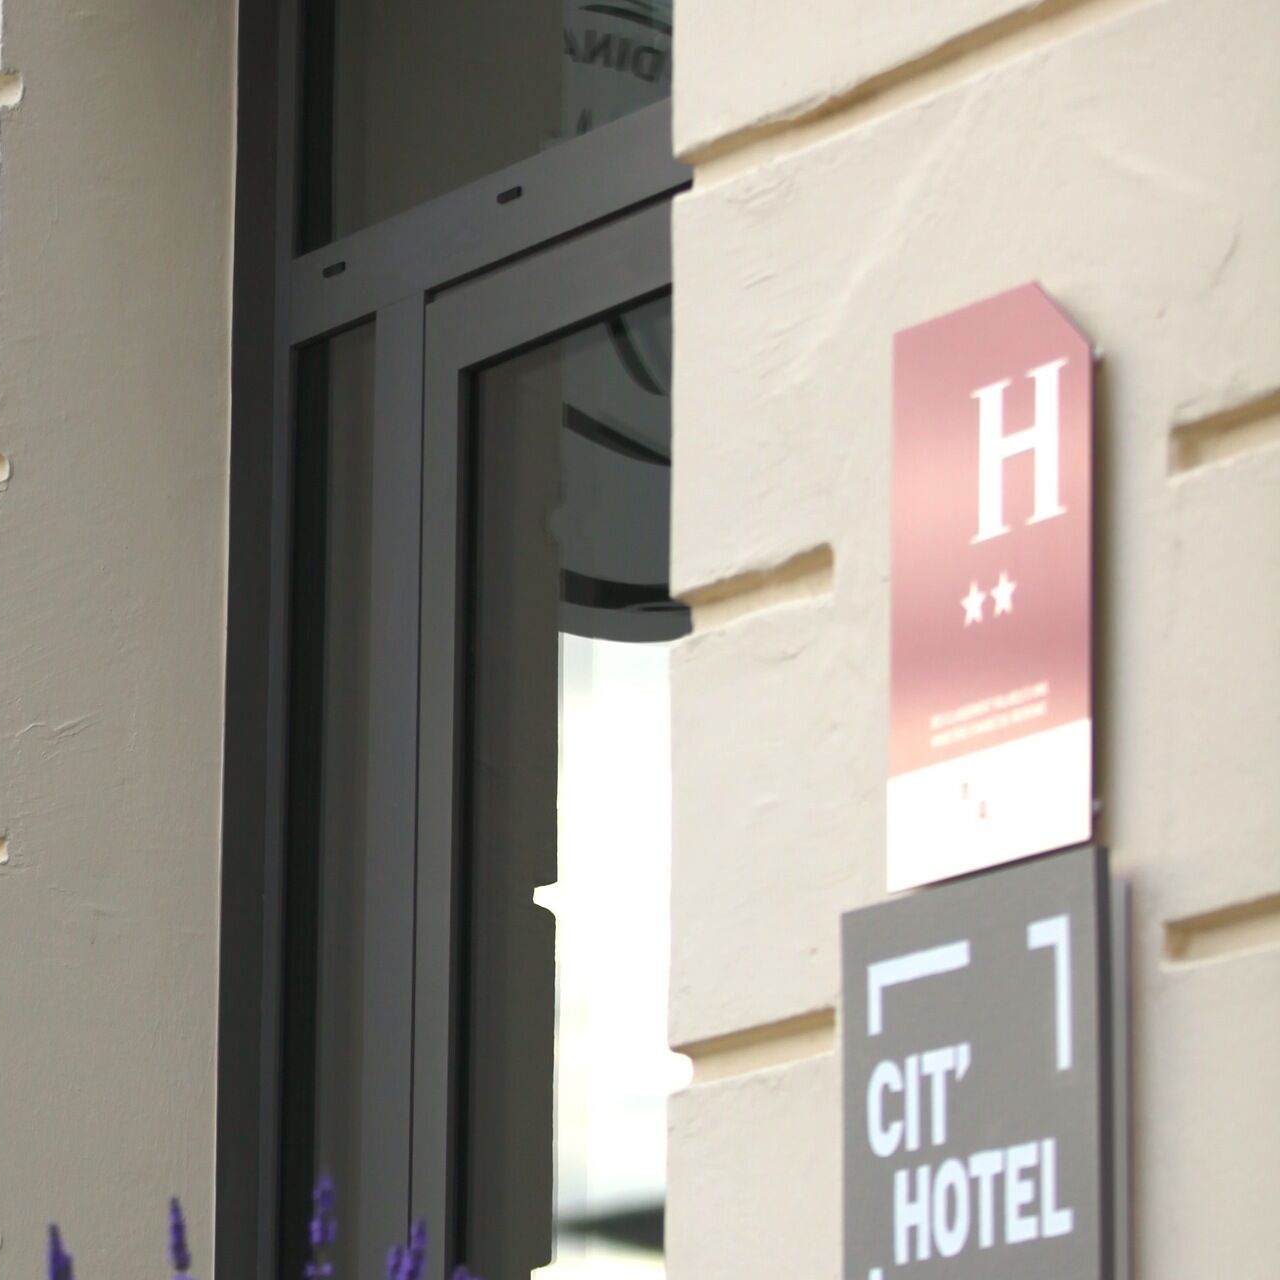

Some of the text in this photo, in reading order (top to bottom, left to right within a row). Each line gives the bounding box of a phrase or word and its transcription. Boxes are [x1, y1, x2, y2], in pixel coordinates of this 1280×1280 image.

[969, 356, 1071, 546] H
[867, 1041, 972, 1159] CIT'
[893, 1138, 1074, 1266] HOTEL
